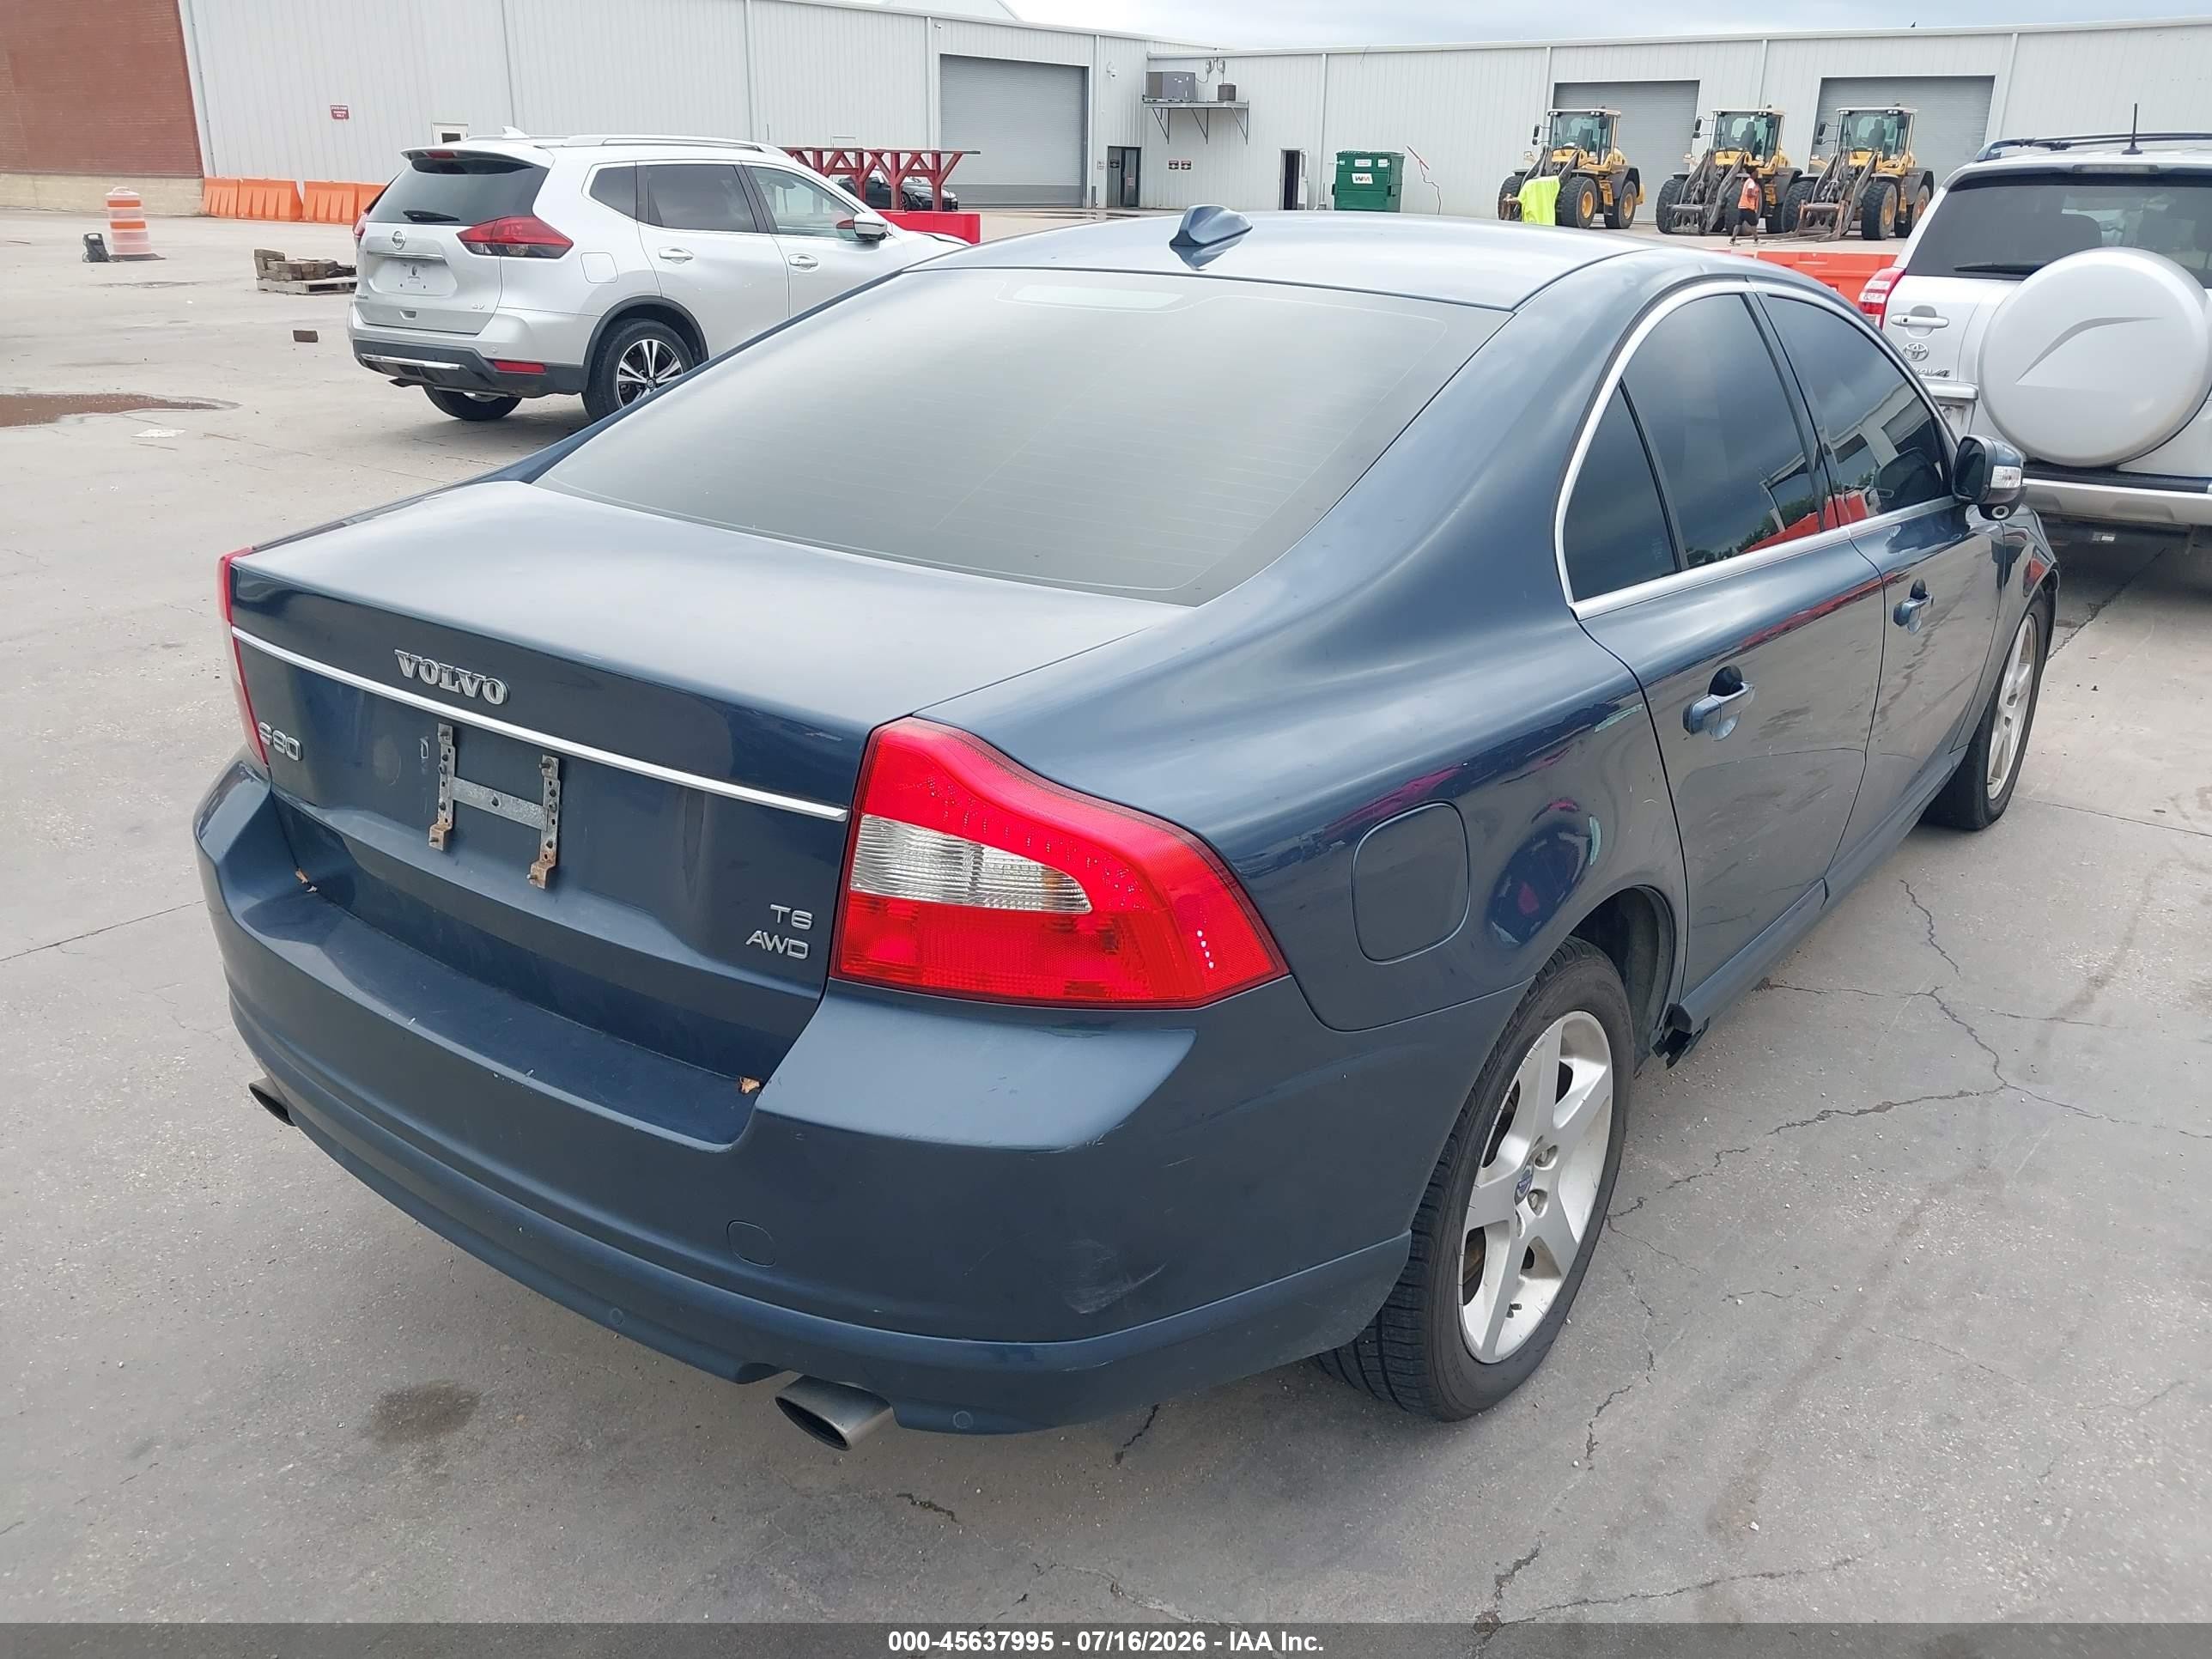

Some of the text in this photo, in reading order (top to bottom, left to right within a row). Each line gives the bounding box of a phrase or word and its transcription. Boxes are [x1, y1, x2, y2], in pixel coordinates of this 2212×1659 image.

[393, 648, 509, 705] VOLVO
[258, 721, 302, 762] S80
[769, 903, 813, 930] T6
[745, 930, 809, 960] AWD
